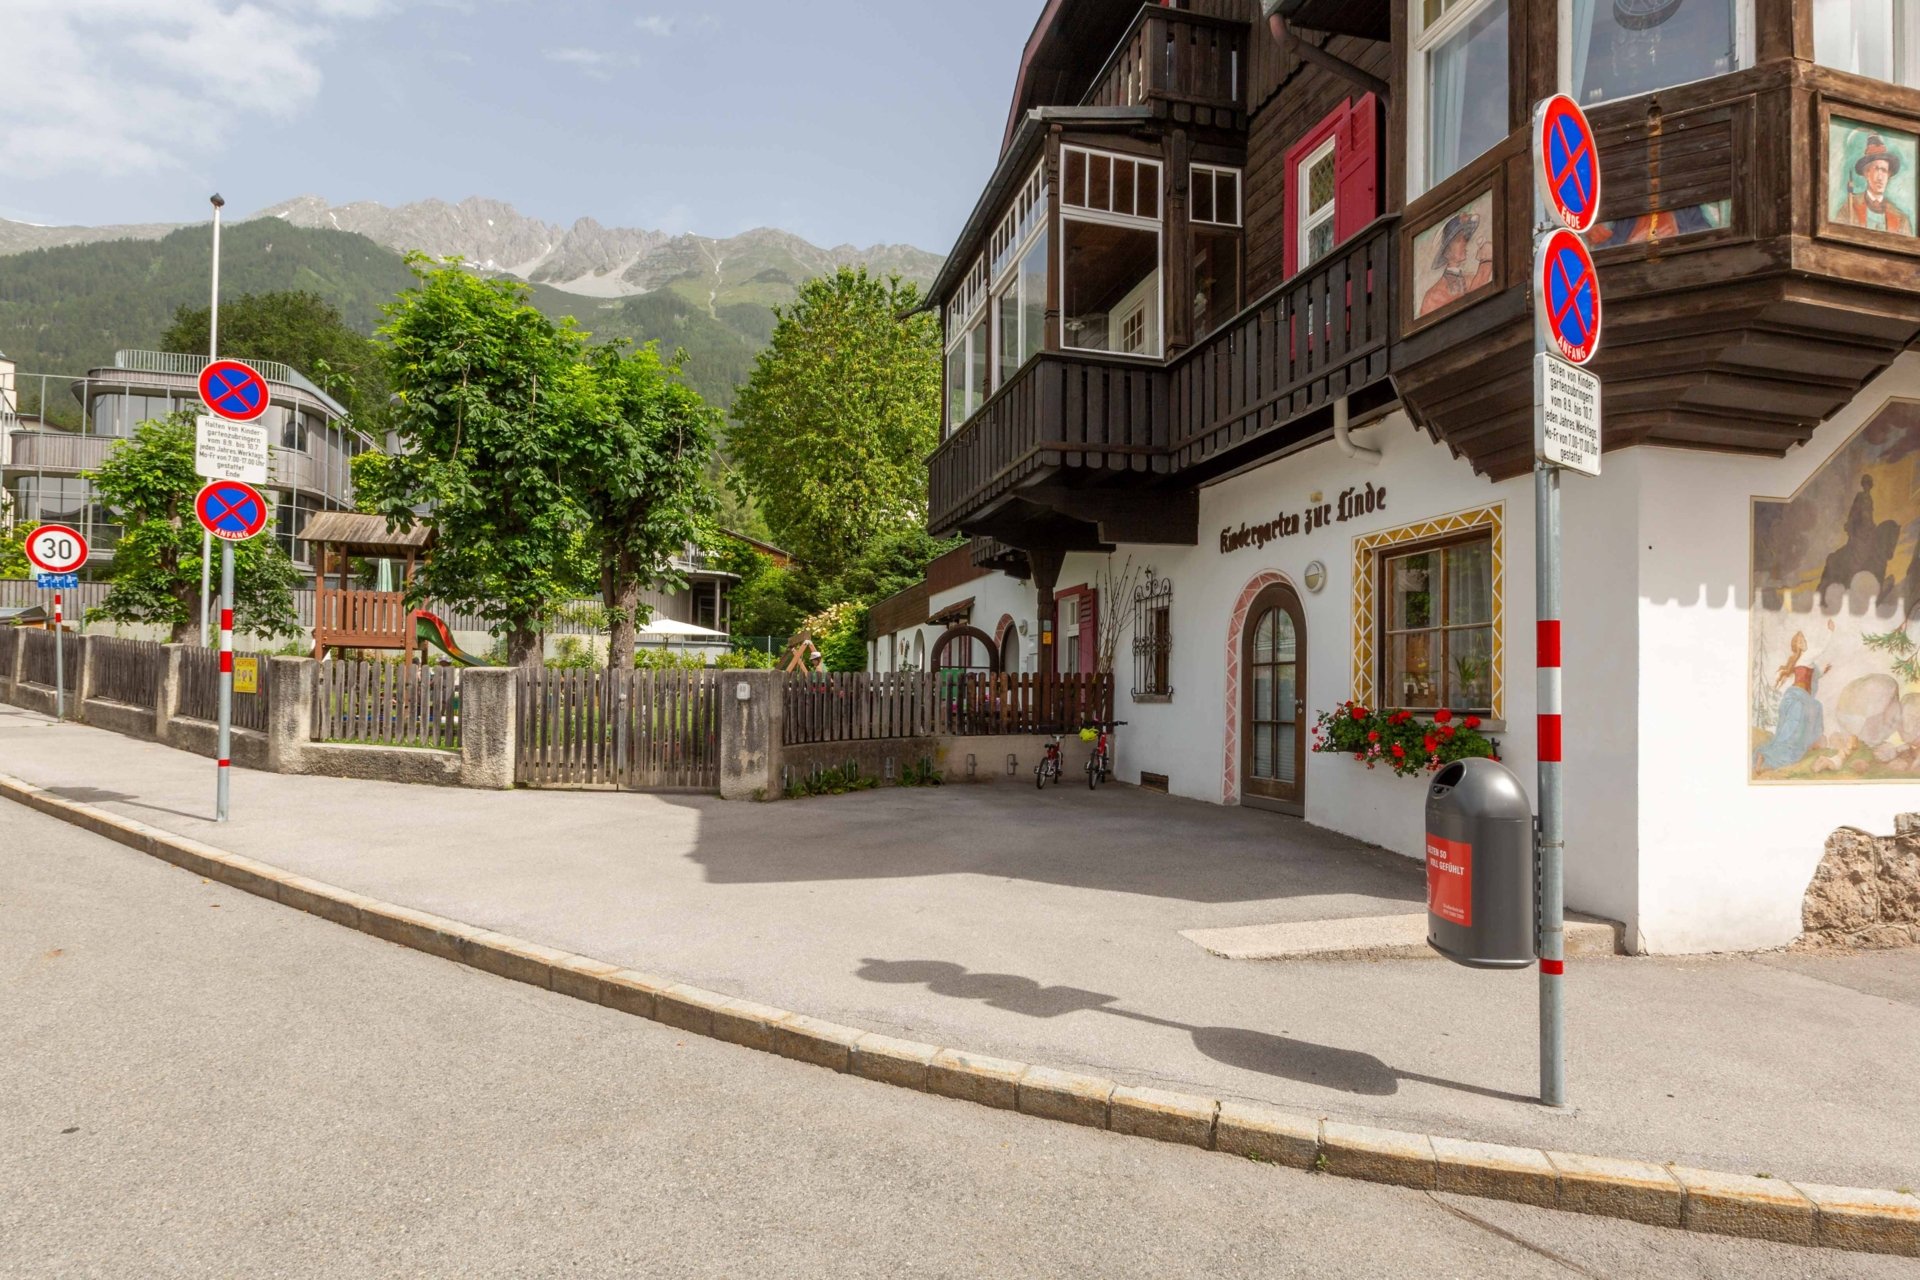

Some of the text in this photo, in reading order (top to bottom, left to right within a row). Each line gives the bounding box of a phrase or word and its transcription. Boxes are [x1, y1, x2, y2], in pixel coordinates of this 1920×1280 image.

[1562, 206, 1580, 229] ENDE
[1558, 336, 1586, 360] ANFANG
[1549, 359, 1595, 391] Halten von Kinder-
[1550, 378, 1593, 405] gartenzubringern
[1551, 395, 1561, 408] vom
[1545, 407, 1558, 424] jeden
[205, 420, 225, 429] Halten
[241, 427, 263, 436] Kinder-
[207, 430, 260, 444] gartenzubringern
[236, 441, 245, 449] bis
[1545, 424, 1558, 440] Mo-Fr
[1590, 442, 1598, 455] Uhr
[199, 451, 216, 459] Mo-Fr
[1560, 448, 1582, 464] gestattet
[217, 462, 244, 471] gestattet
[1220, 482, 1386, 554] Kindergarten zur Linde
[214, 527, 249, 539] ANFANG
[43, 538, 71, 559] 30
[1440, 849, 1447, 859] SO
[1439, 861, 1464, 876] GEFÜHLT
